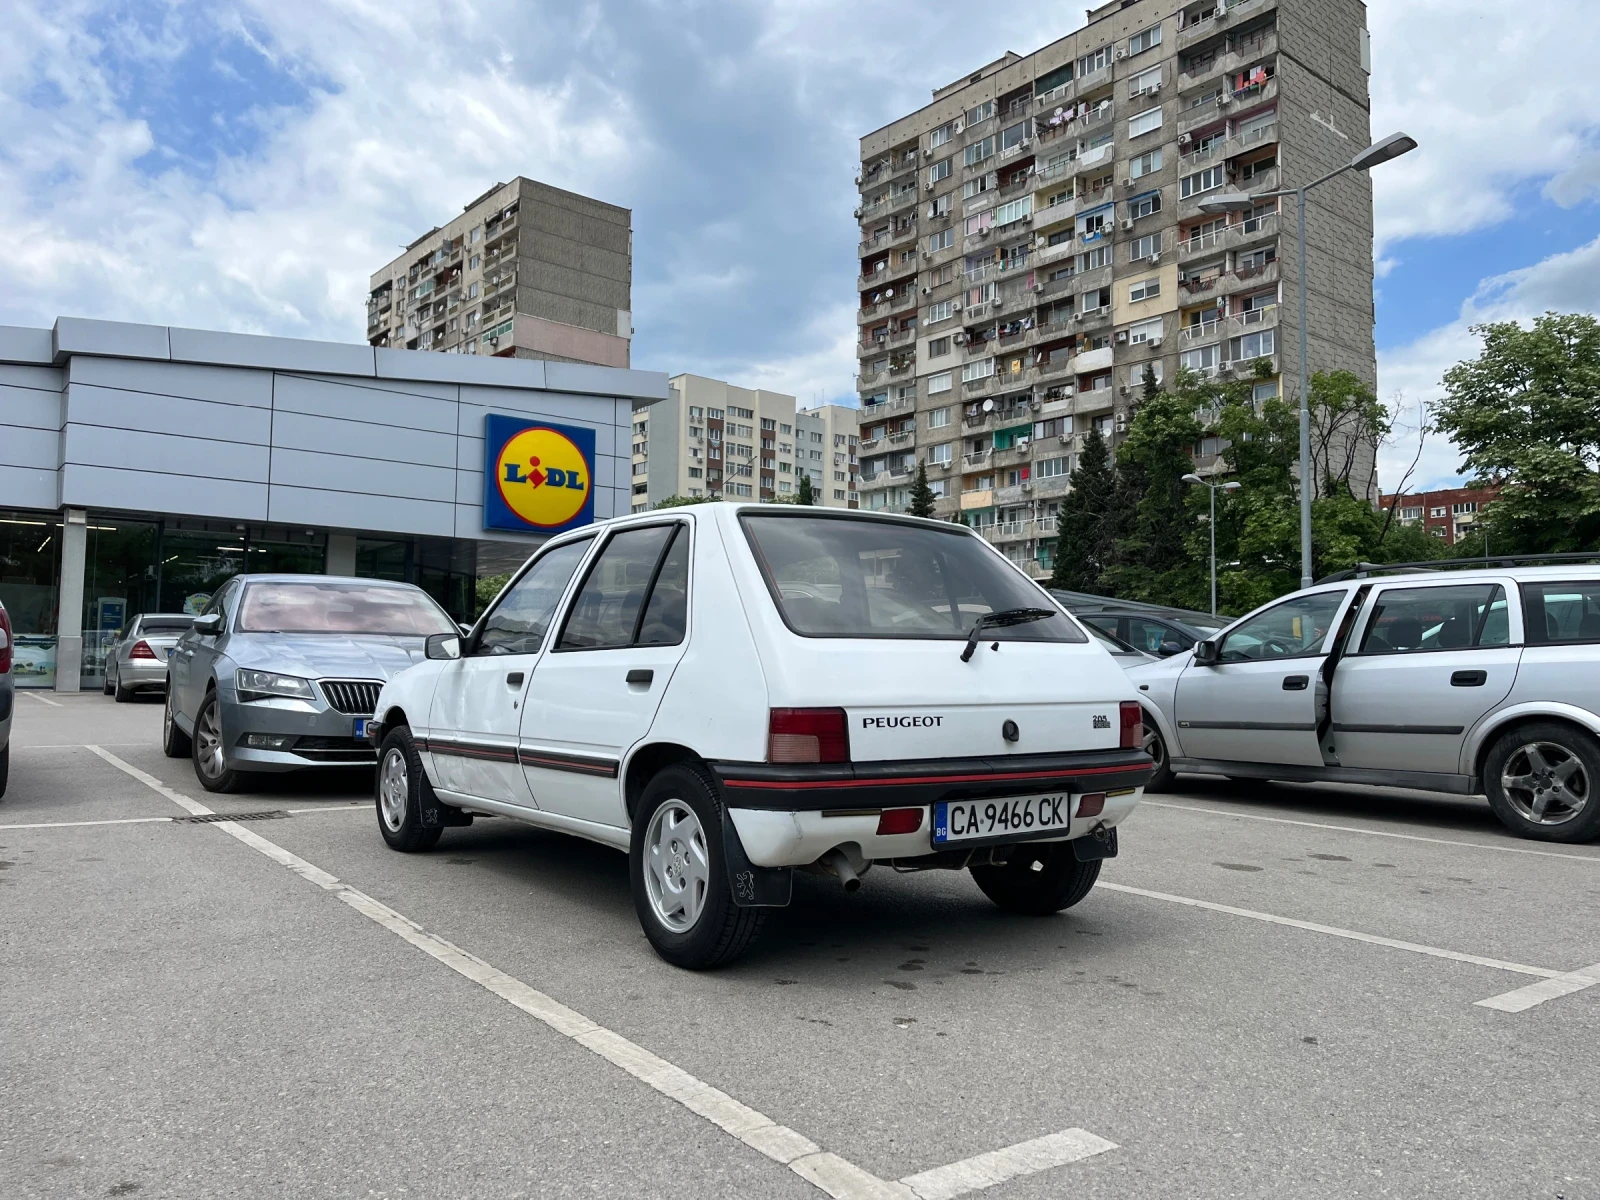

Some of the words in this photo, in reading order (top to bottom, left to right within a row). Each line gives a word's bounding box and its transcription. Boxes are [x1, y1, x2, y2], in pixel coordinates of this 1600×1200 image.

[862, 716, 943, 729] PEUGEOT
[951, 804, 979, 835] CA
[984, 799, 1034, 832] 9466
[1039, 796, 1064, 826] CK
[936, 827, 946, 836] BG
